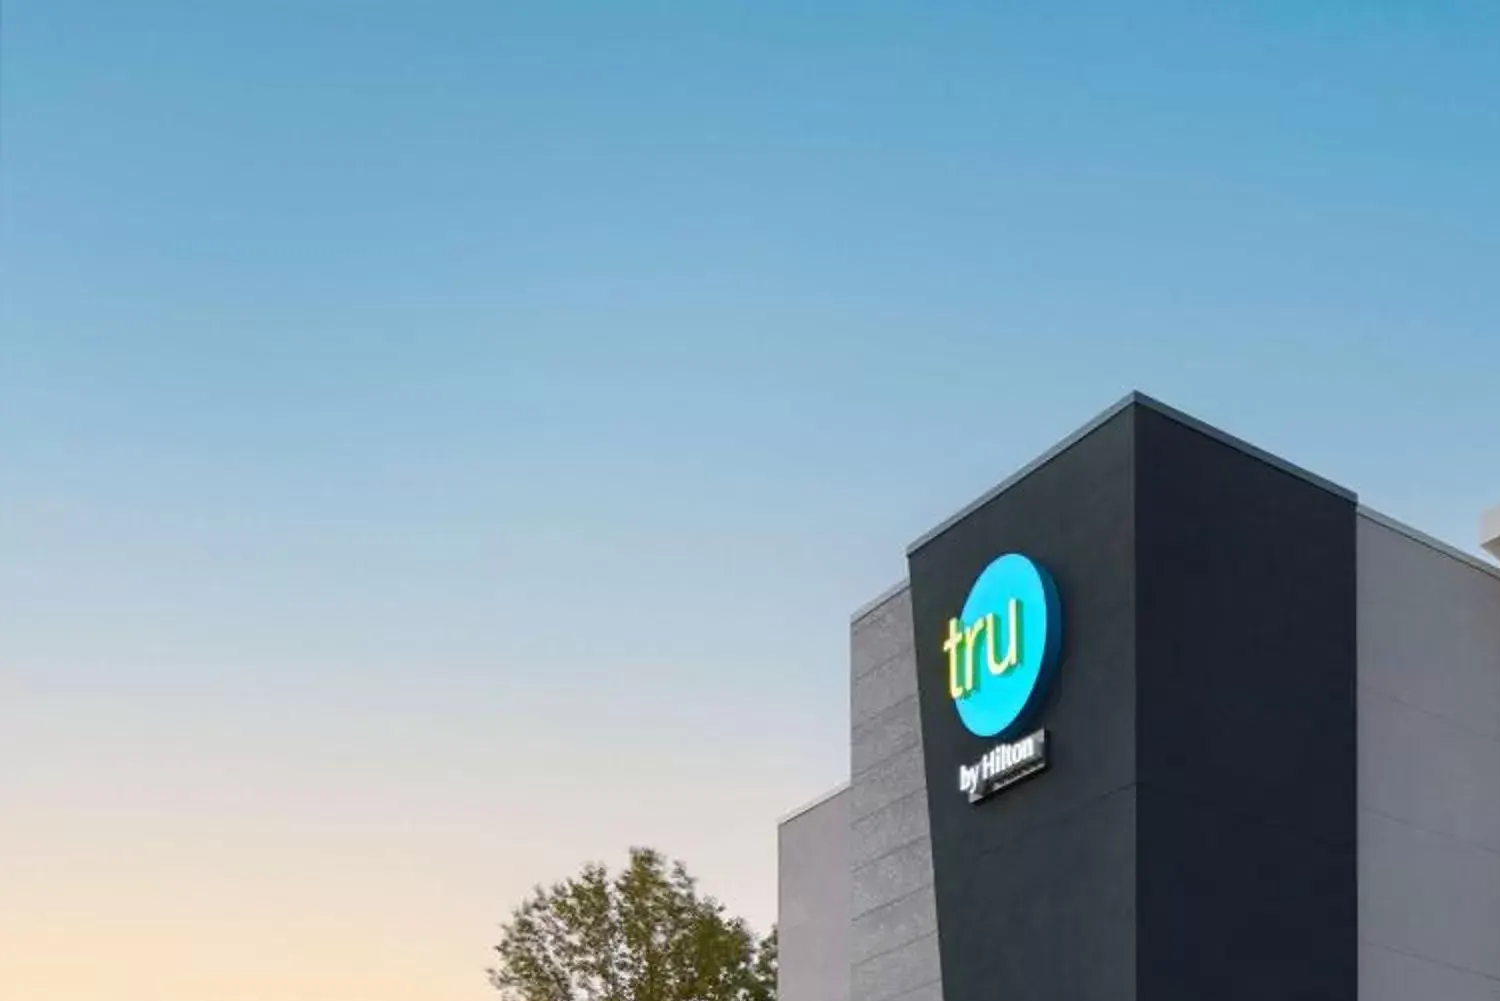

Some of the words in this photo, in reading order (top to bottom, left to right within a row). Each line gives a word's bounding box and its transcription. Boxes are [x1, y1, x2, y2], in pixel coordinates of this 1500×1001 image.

[944, 597, 1018, 699] tru
[959, 764, 979, 794] by
[982, 737, 1034, 779] Hilton
